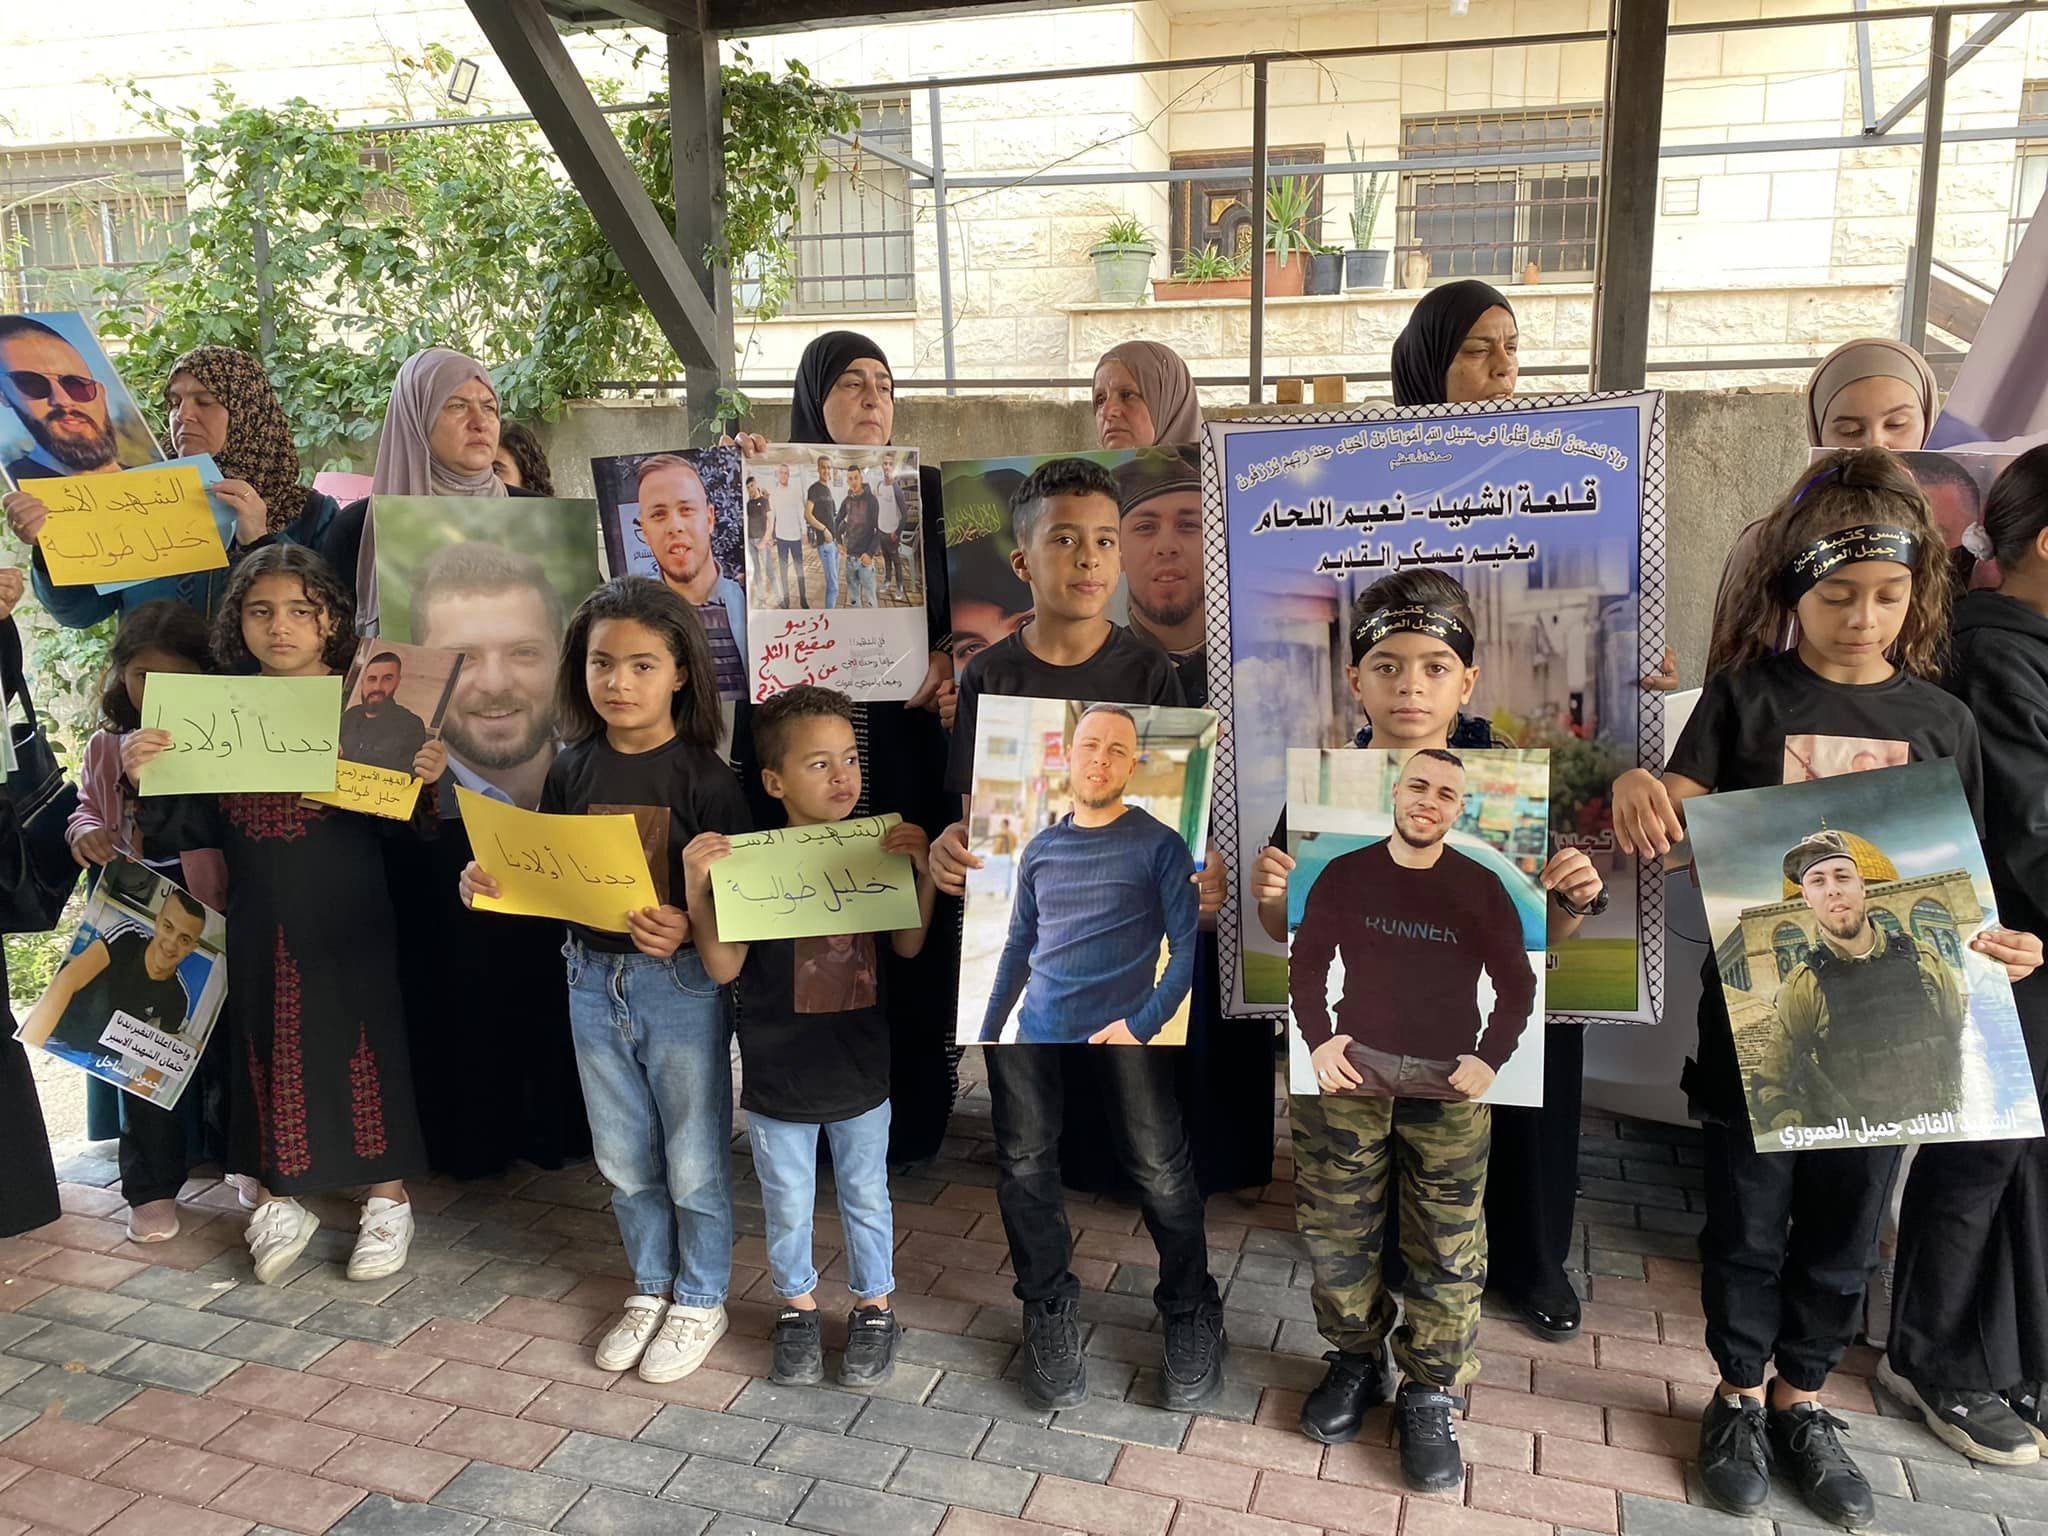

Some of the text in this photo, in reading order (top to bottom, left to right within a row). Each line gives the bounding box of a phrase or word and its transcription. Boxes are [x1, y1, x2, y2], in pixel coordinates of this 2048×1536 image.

[1336, 493, 1406, 533] نعيم
[1518, 478, 1597, 514] قلعة
[1253, 498, 1332, 533] اللحام
[1316, 537, 1535, 578] مخيم عسكر القديم
[1816, 528, 1866, 552] كتيبة
[1811, 544, 1897, 579] جميل العموري
[258, 715, 332, 756] بدنا
[568, 853, 636, 888] بدنا
[131, 1044, 159, 1062] الشهيد
[1779, 1116, 1851, 1149] العموري
[1854, 1116, 1903, 1144] جميل
[1907, 1108, 1956, 1137] القائد
